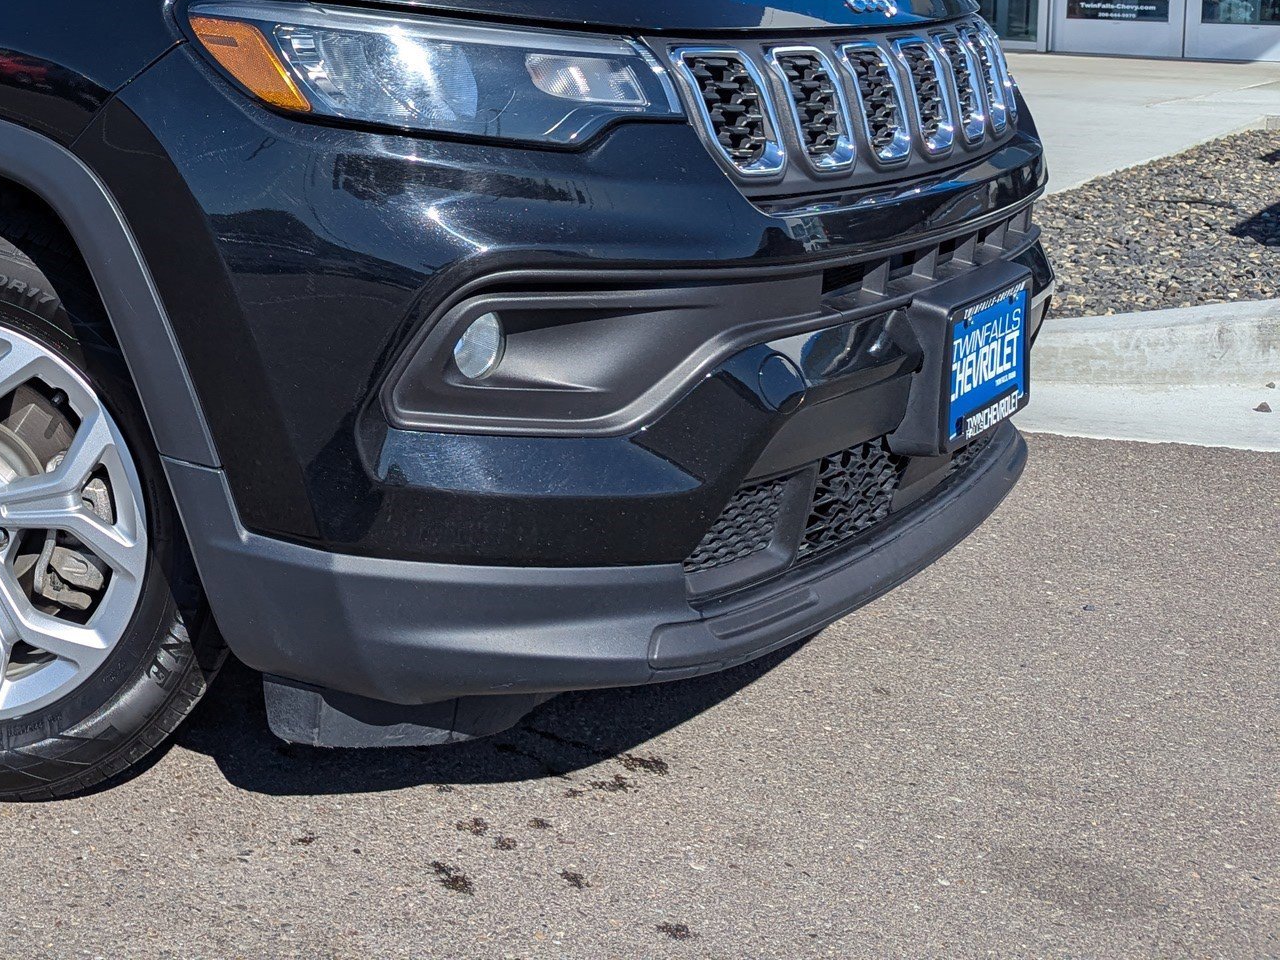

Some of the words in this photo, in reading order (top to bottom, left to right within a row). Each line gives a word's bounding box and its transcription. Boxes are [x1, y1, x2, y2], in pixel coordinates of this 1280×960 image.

[1080, 2, 1156, 11] TwinFalls-Chevy.com
[953, 308, 1021, 362] TWINFALLS
[983, 389, 1019, 429] CHEVROLET
